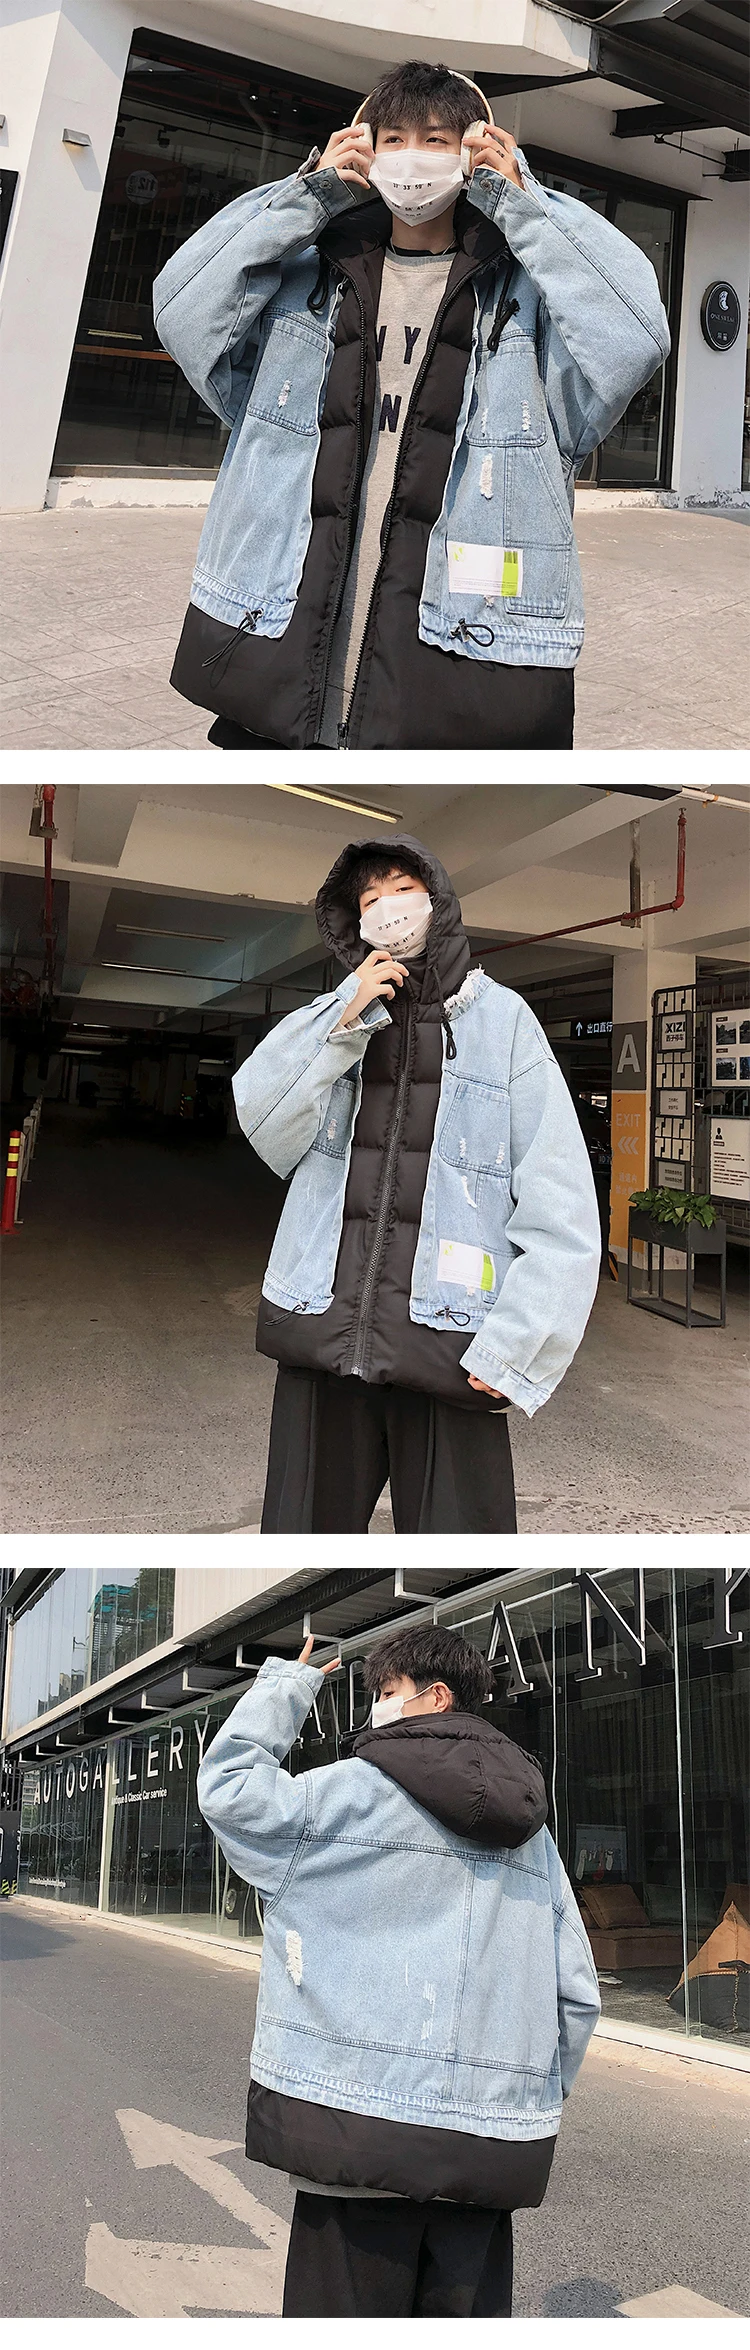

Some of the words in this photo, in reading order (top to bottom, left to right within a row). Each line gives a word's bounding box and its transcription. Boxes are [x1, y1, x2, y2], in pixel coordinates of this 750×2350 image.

[586, 1021, 613, 1034] 出口直行
[665, 1021, 686, 1033] XIZI
[616, 1033, 641, 1074] A
[615, 1113, 641, 1128] EXIT
[34, 1714, 210, 1806] AUTOGALLERY
[128, 1791, 142, 1802] Classic
[142, 1790, 150, 1800] Car
[151, 1787, 167, 1799] service
